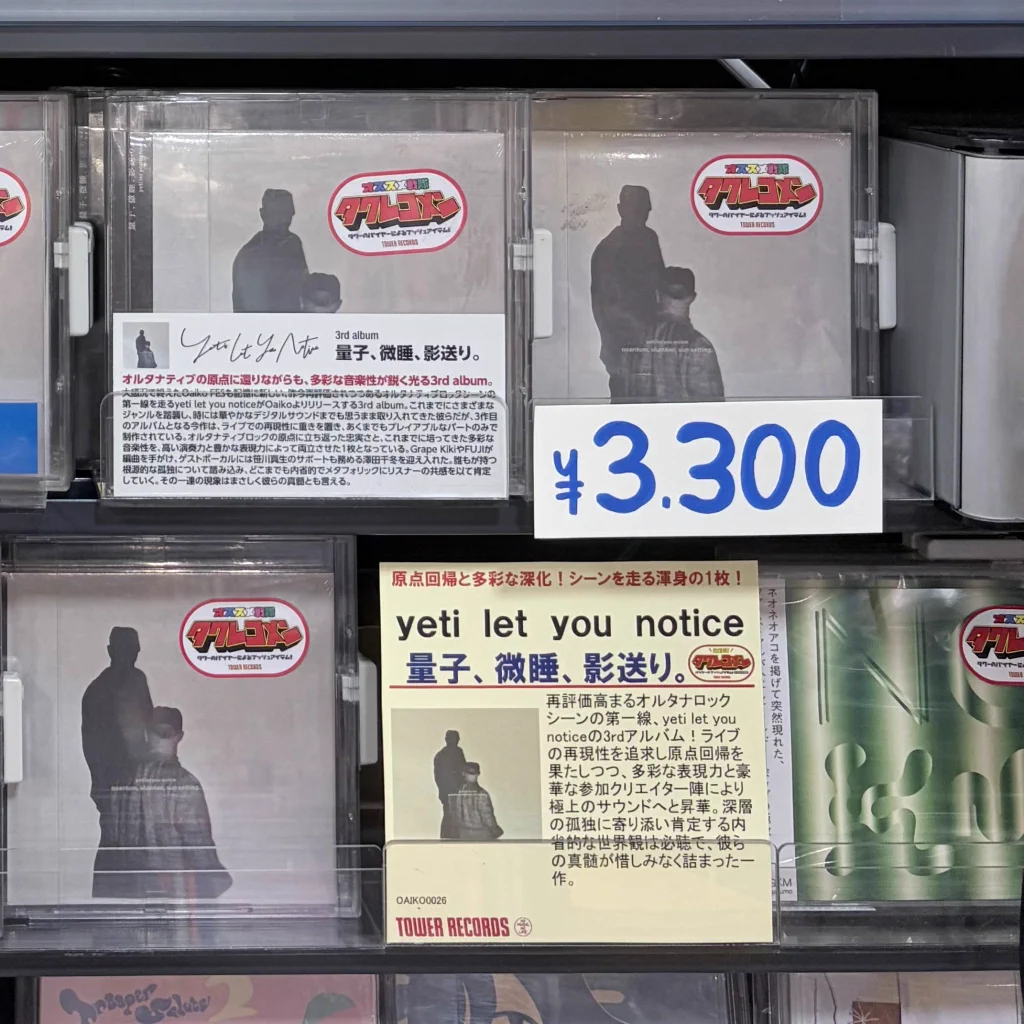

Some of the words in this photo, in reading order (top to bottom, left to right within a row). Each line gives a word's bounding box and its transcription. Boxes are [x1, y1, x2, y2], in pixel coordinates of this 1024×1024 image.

[335, 331, 350, 340] 3rd
[352, 331, 379, 340] album
[335, 344, 480, 362] 量子、微睡、影送り。
[194, 400, 206, 408] let
[209, 402, 226, 410] you
[396, 609, 460, 641] yeti
[484, 609, 527, 638] let
[550, 614, 612, 641] you
[636, 608, 744, 637] notice
[406, 652, 685, 684] 量子、微睡、影送り。
[546, 693, 731, 709] 再評価高まるオルタナロック
[546, 711, 687, 726] シーンの第一線、yeti
[691, 712, 712, 724] let
[713, 715, 736, 726] you
[548, 746, 744, 761] の再現性を追求し原点回帰を
[549, 764, 751, 779] 果たしつつ、多彩な表現力と豪
[549, 781, 744, 796] 華な参加クリエイター陣により
[550, 817, 746, 832] の孤独に寄り添い肯定する内
[552, 853, 755, 869] の真髄が惜しみなく詰まった一
[552, 871, 574, 886] 作。
[396, 917, 444, 937] TOWER
[447, 917, 510, 937] RECORDS
